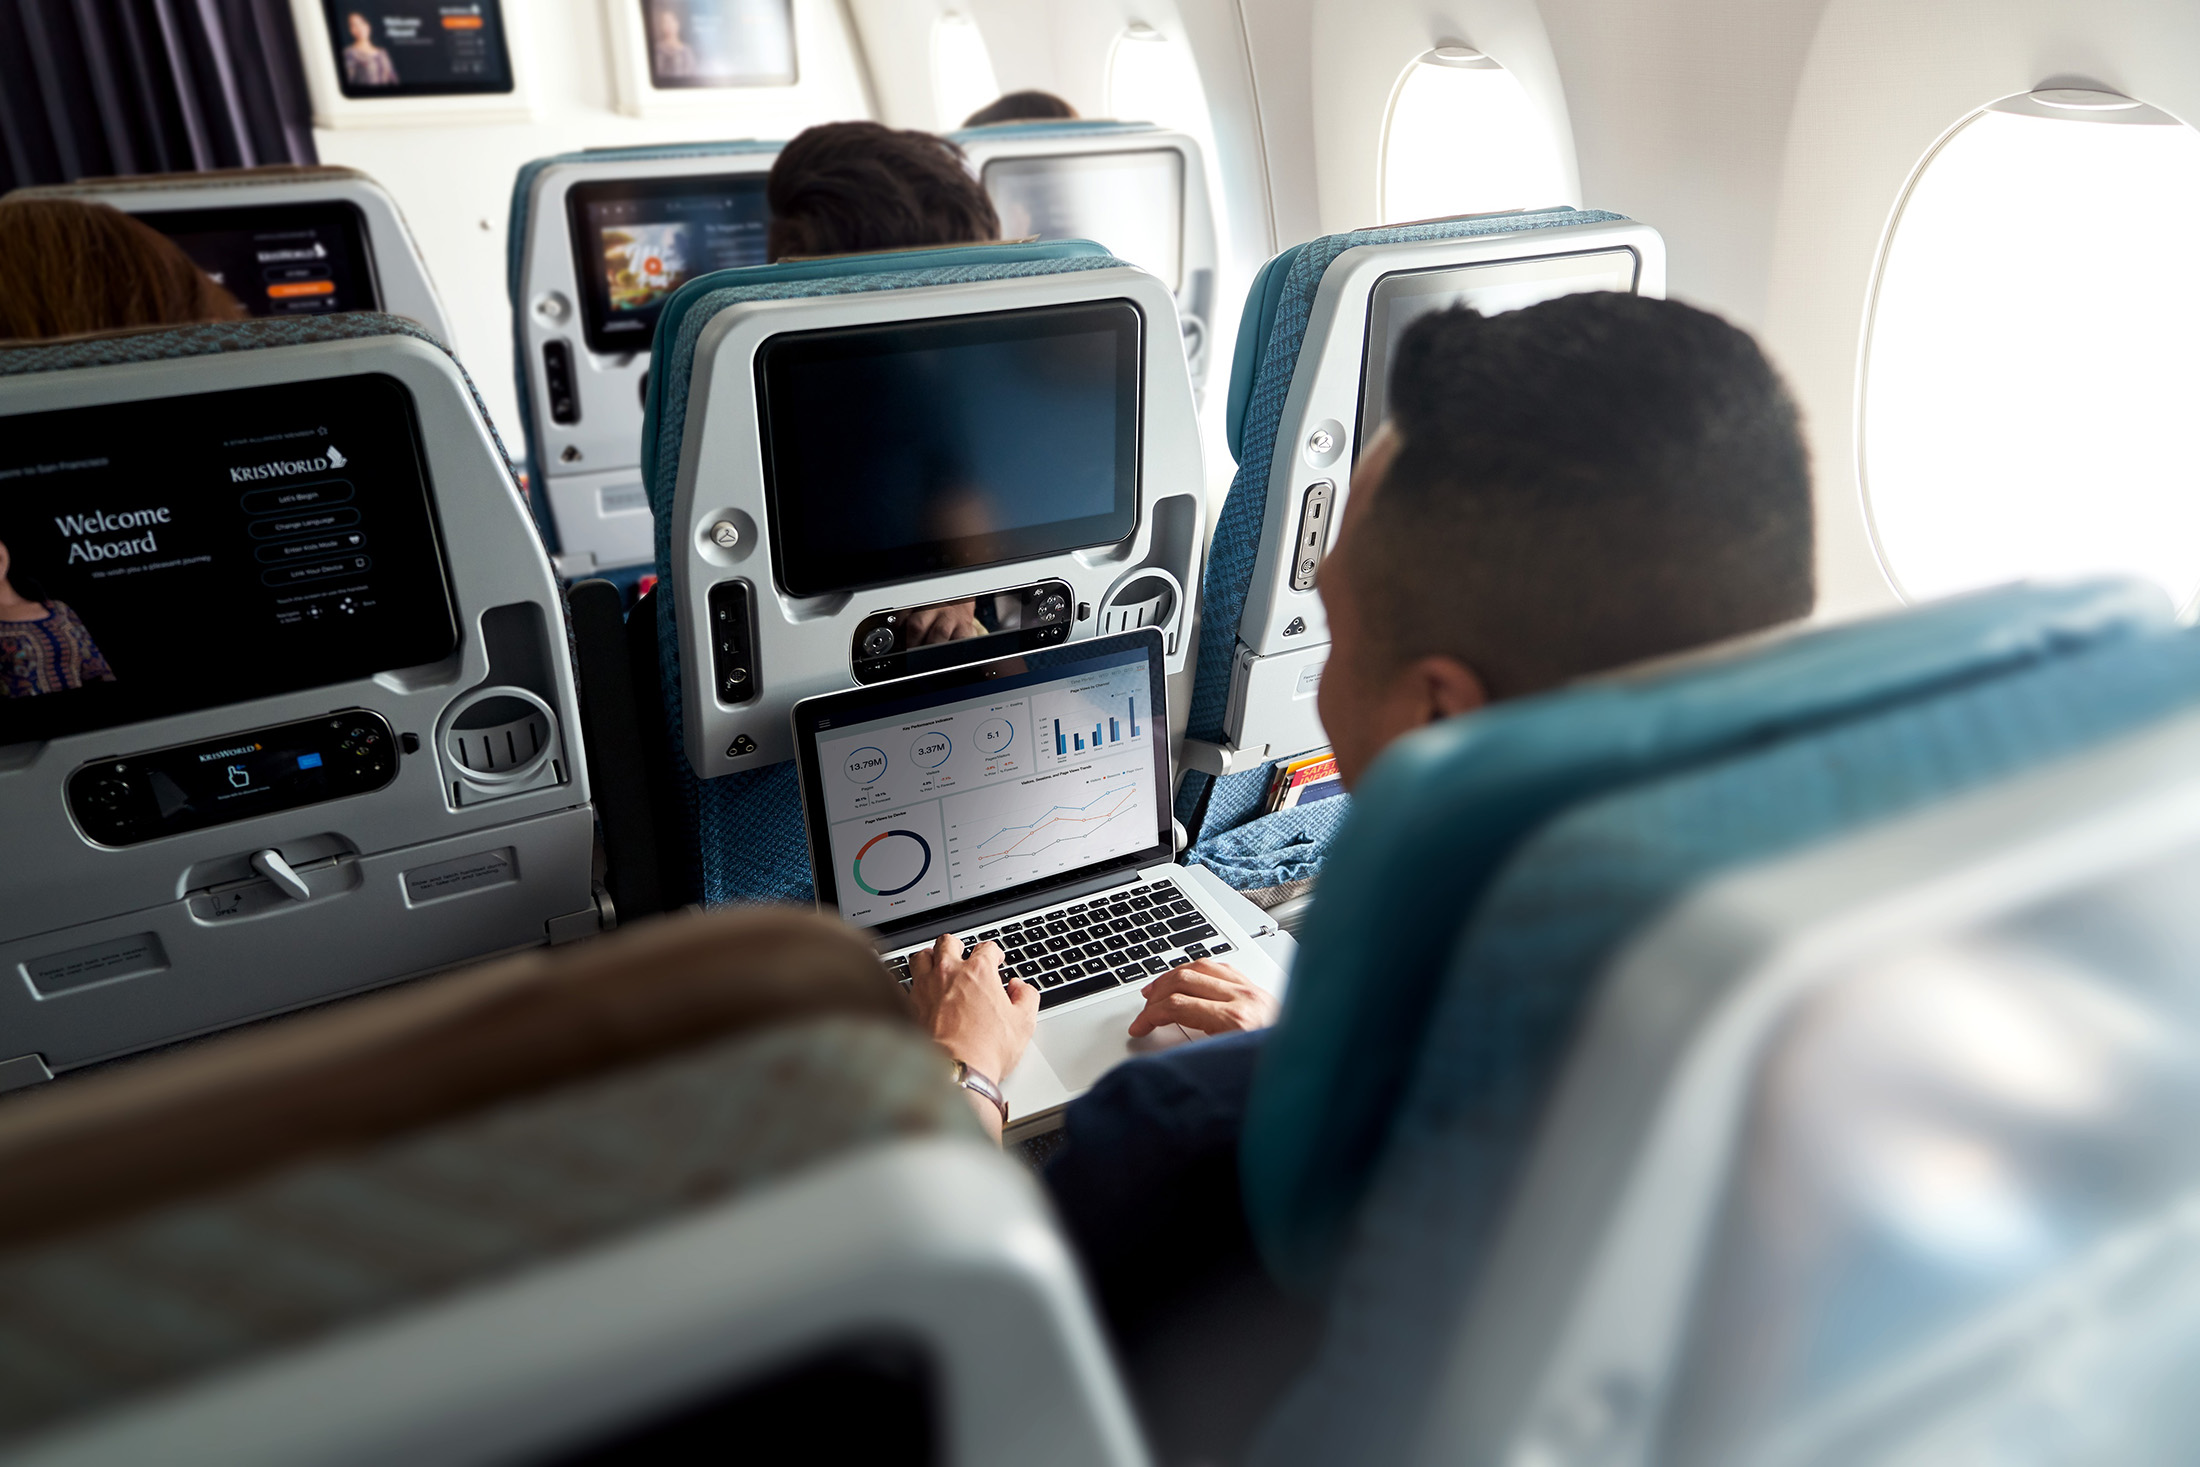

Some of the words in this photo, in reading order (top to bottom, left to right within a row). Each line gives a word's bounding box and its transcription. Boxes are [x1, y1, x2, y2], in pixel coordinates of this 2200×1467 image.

[229, 457, 328, 483] KRISWORLD
[54, 506, 172, 538] Welcome
[67, 529, 159, 565] Aboard
[987, 730, 999, 740] 5.1
[918, 743, 946, 757] 3.37M
[849, 758, 882, 772] 13.79M
[1299, 768, 1341, 786] INFOR
[216, 908, 237, 917] OPEN
